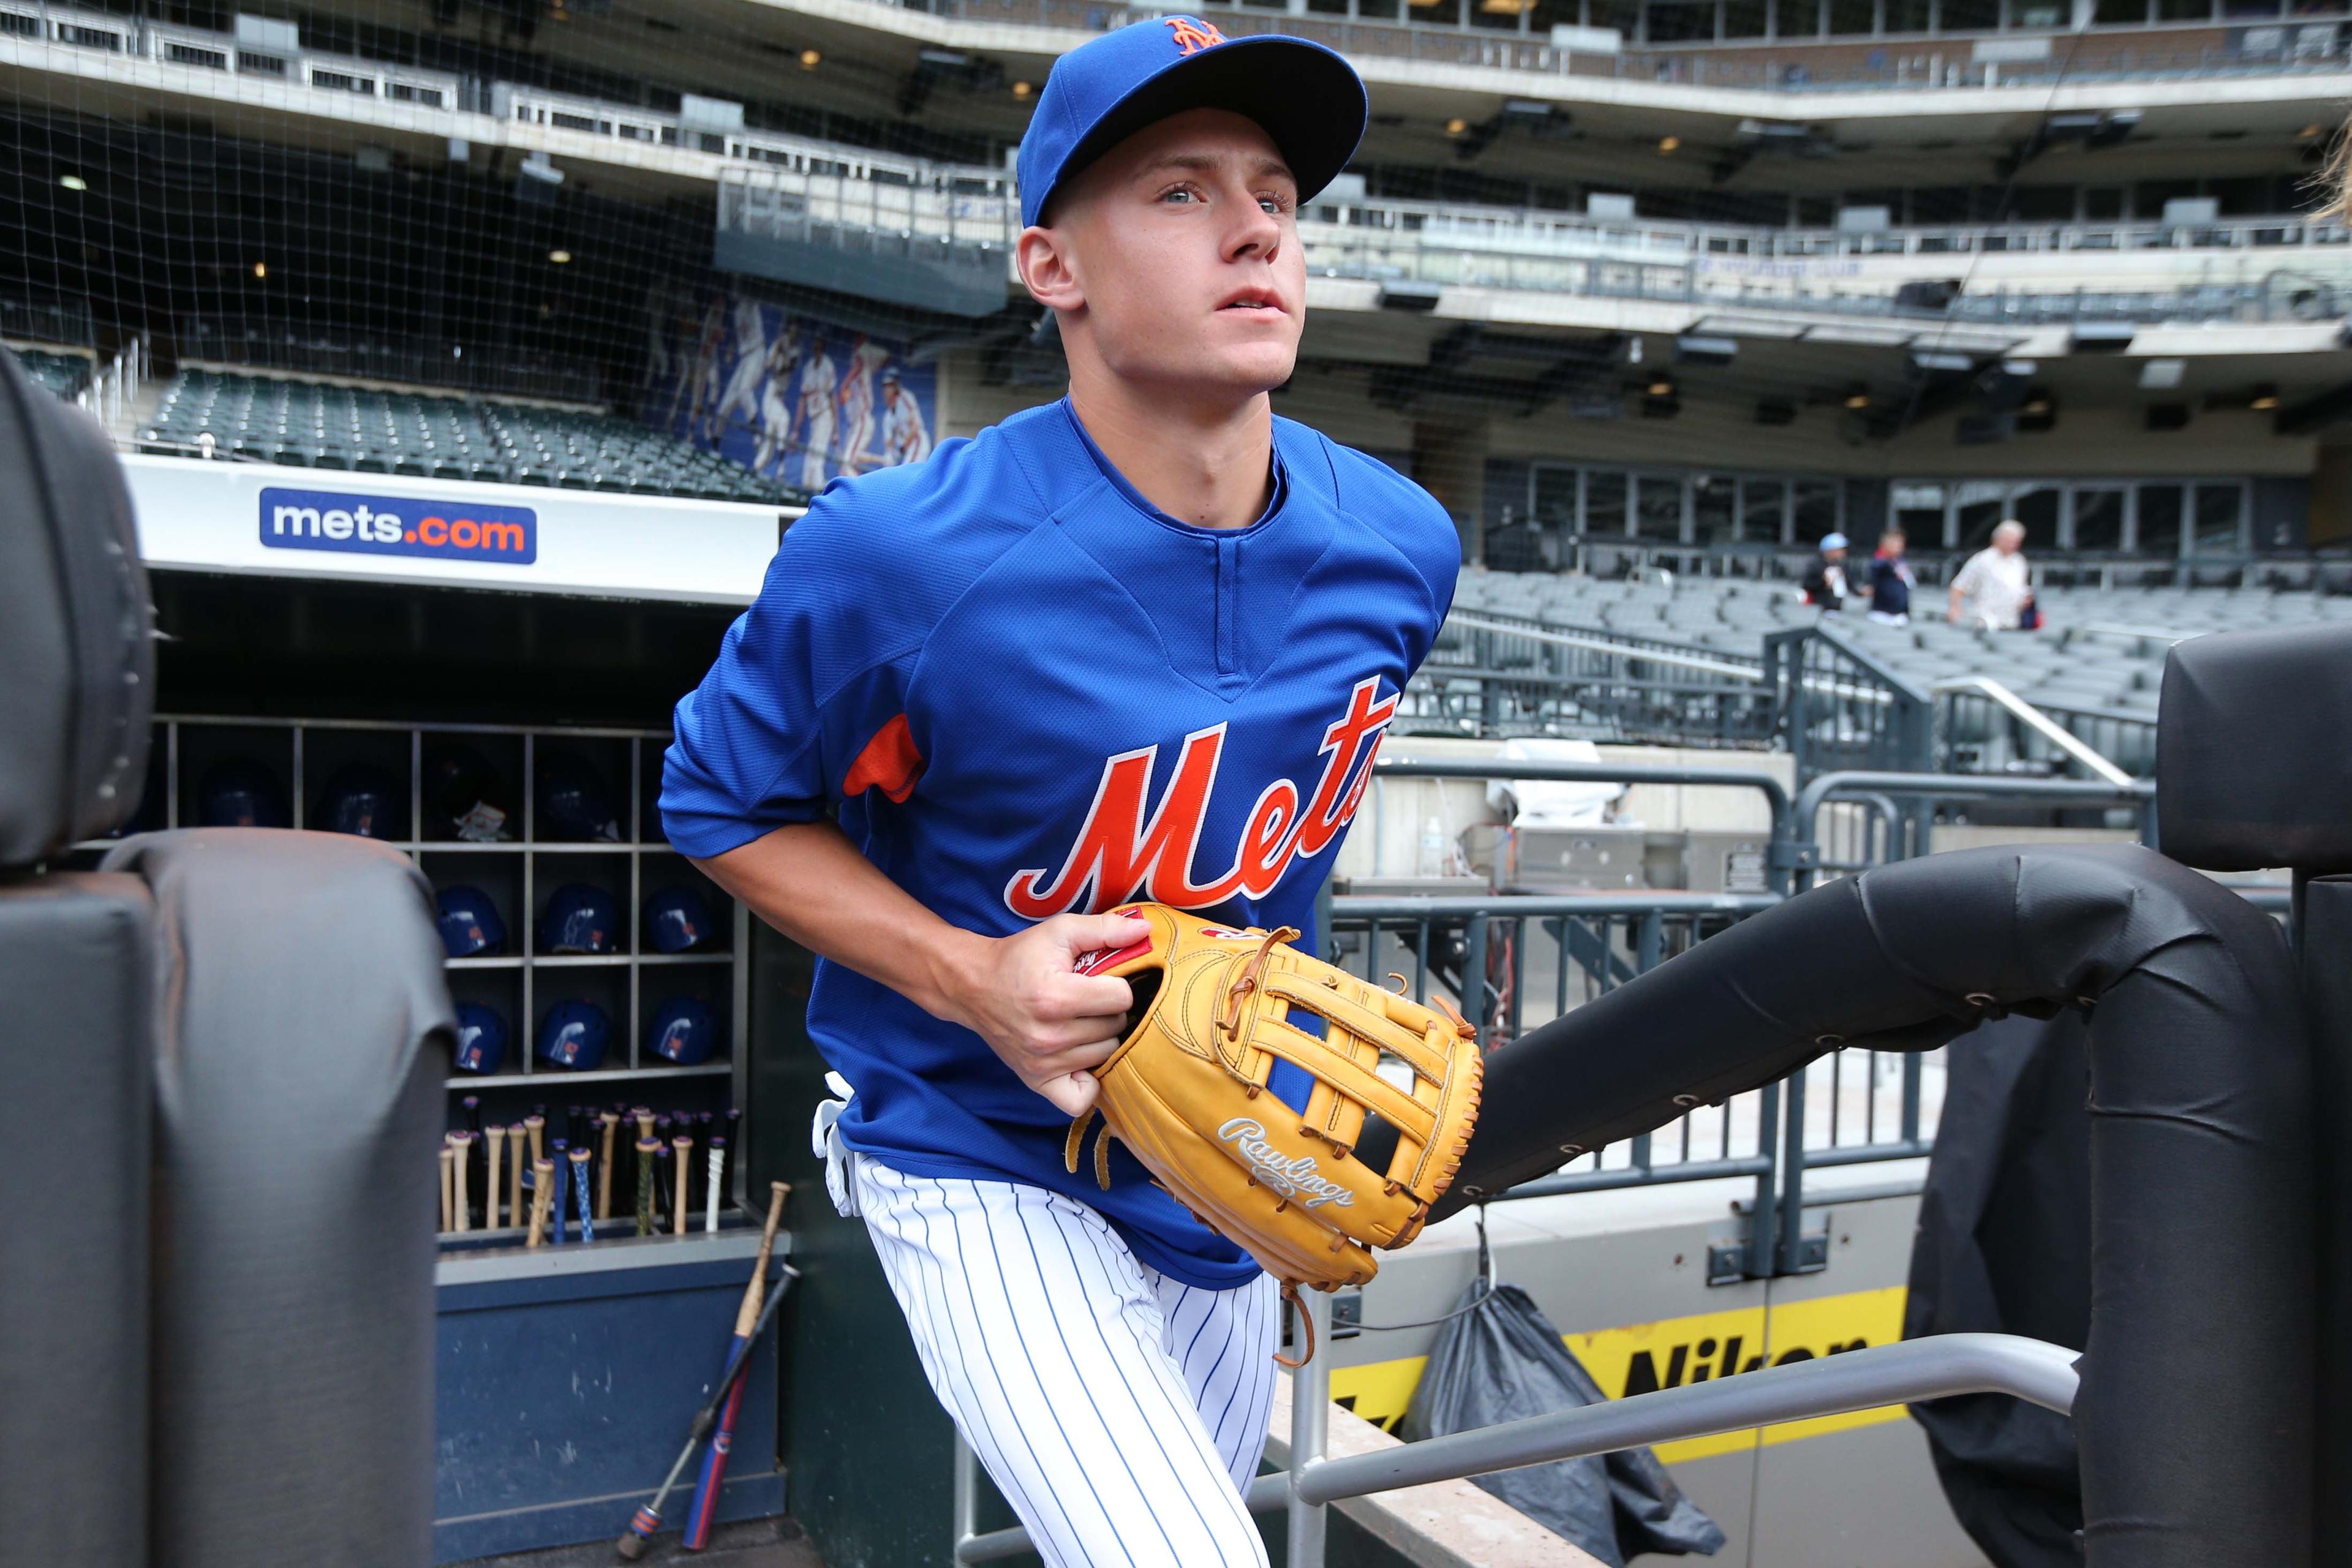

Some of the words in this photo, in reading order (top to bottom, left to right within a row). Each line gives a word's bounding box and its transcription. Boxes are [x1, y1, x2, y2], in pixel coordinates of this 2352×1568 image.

[273, 504, 525, 552] mets.com
[1004, 674, 1401, 921] Mets
[1218, 1117, 1355, 1208] Rawlings
